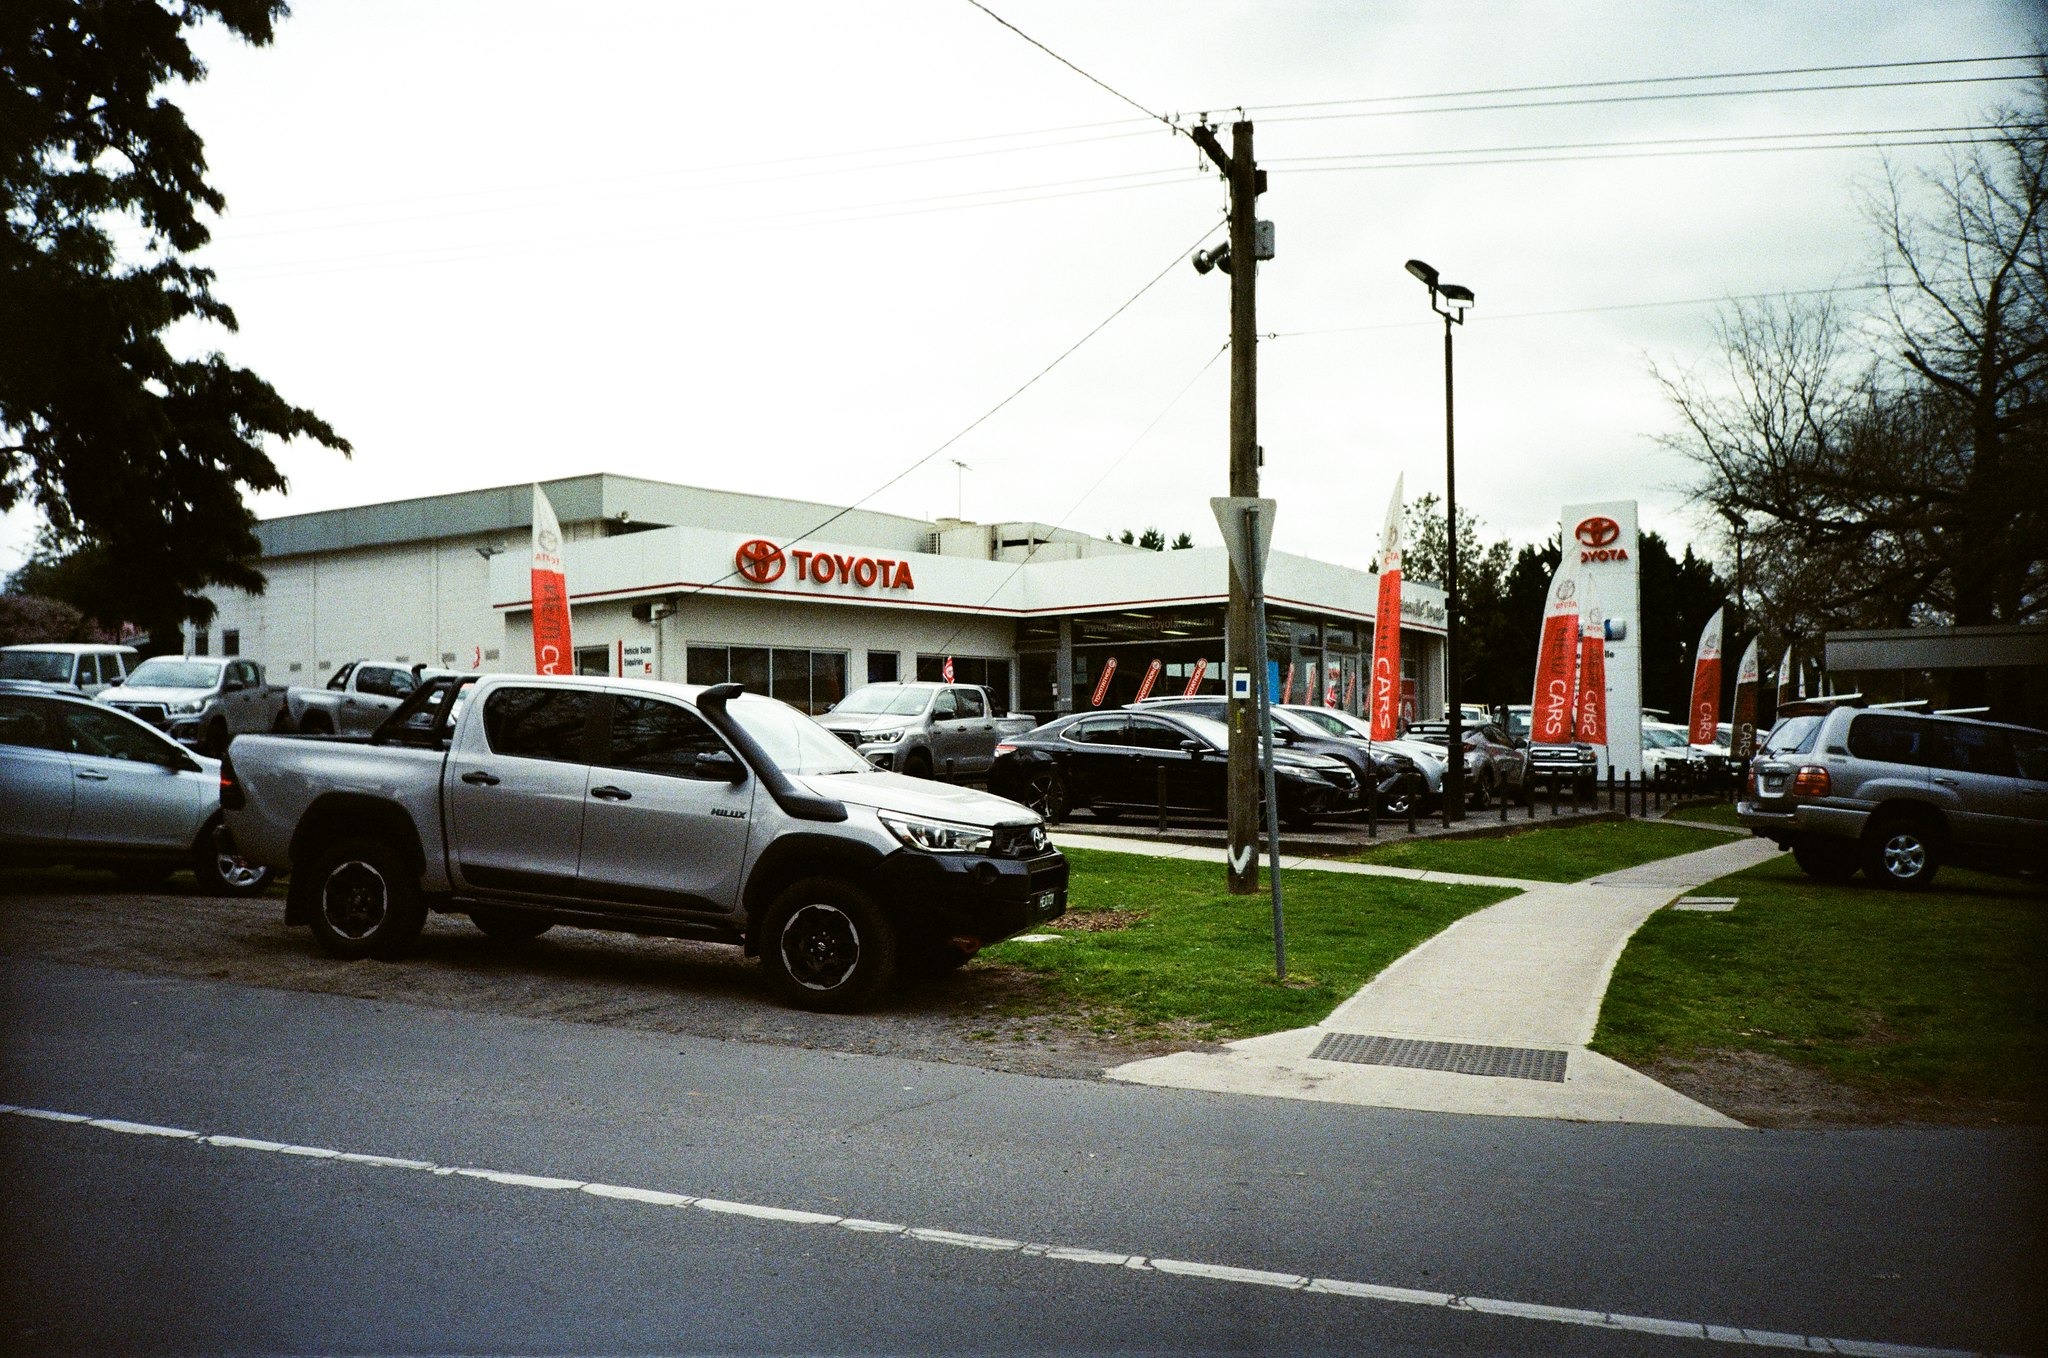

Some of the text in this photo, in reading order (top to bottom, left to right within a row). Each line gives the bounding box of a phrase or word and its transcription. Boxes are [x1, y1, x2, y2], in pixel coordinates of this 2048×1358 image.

[792, 550, 914, 590] TOYOTA
[1580, 548, 1629, 564] OYOTA
[624, 646, 652, 655] Vehicle Sales
[1377, 657, 1391, 729] CARS
[1546, 680, 1566, 735] CARS
[1699, 702, 1711, 740] CARS
[1739, 722, 1752, 757] CARS
[711, 808, 747, 819] HILUX
